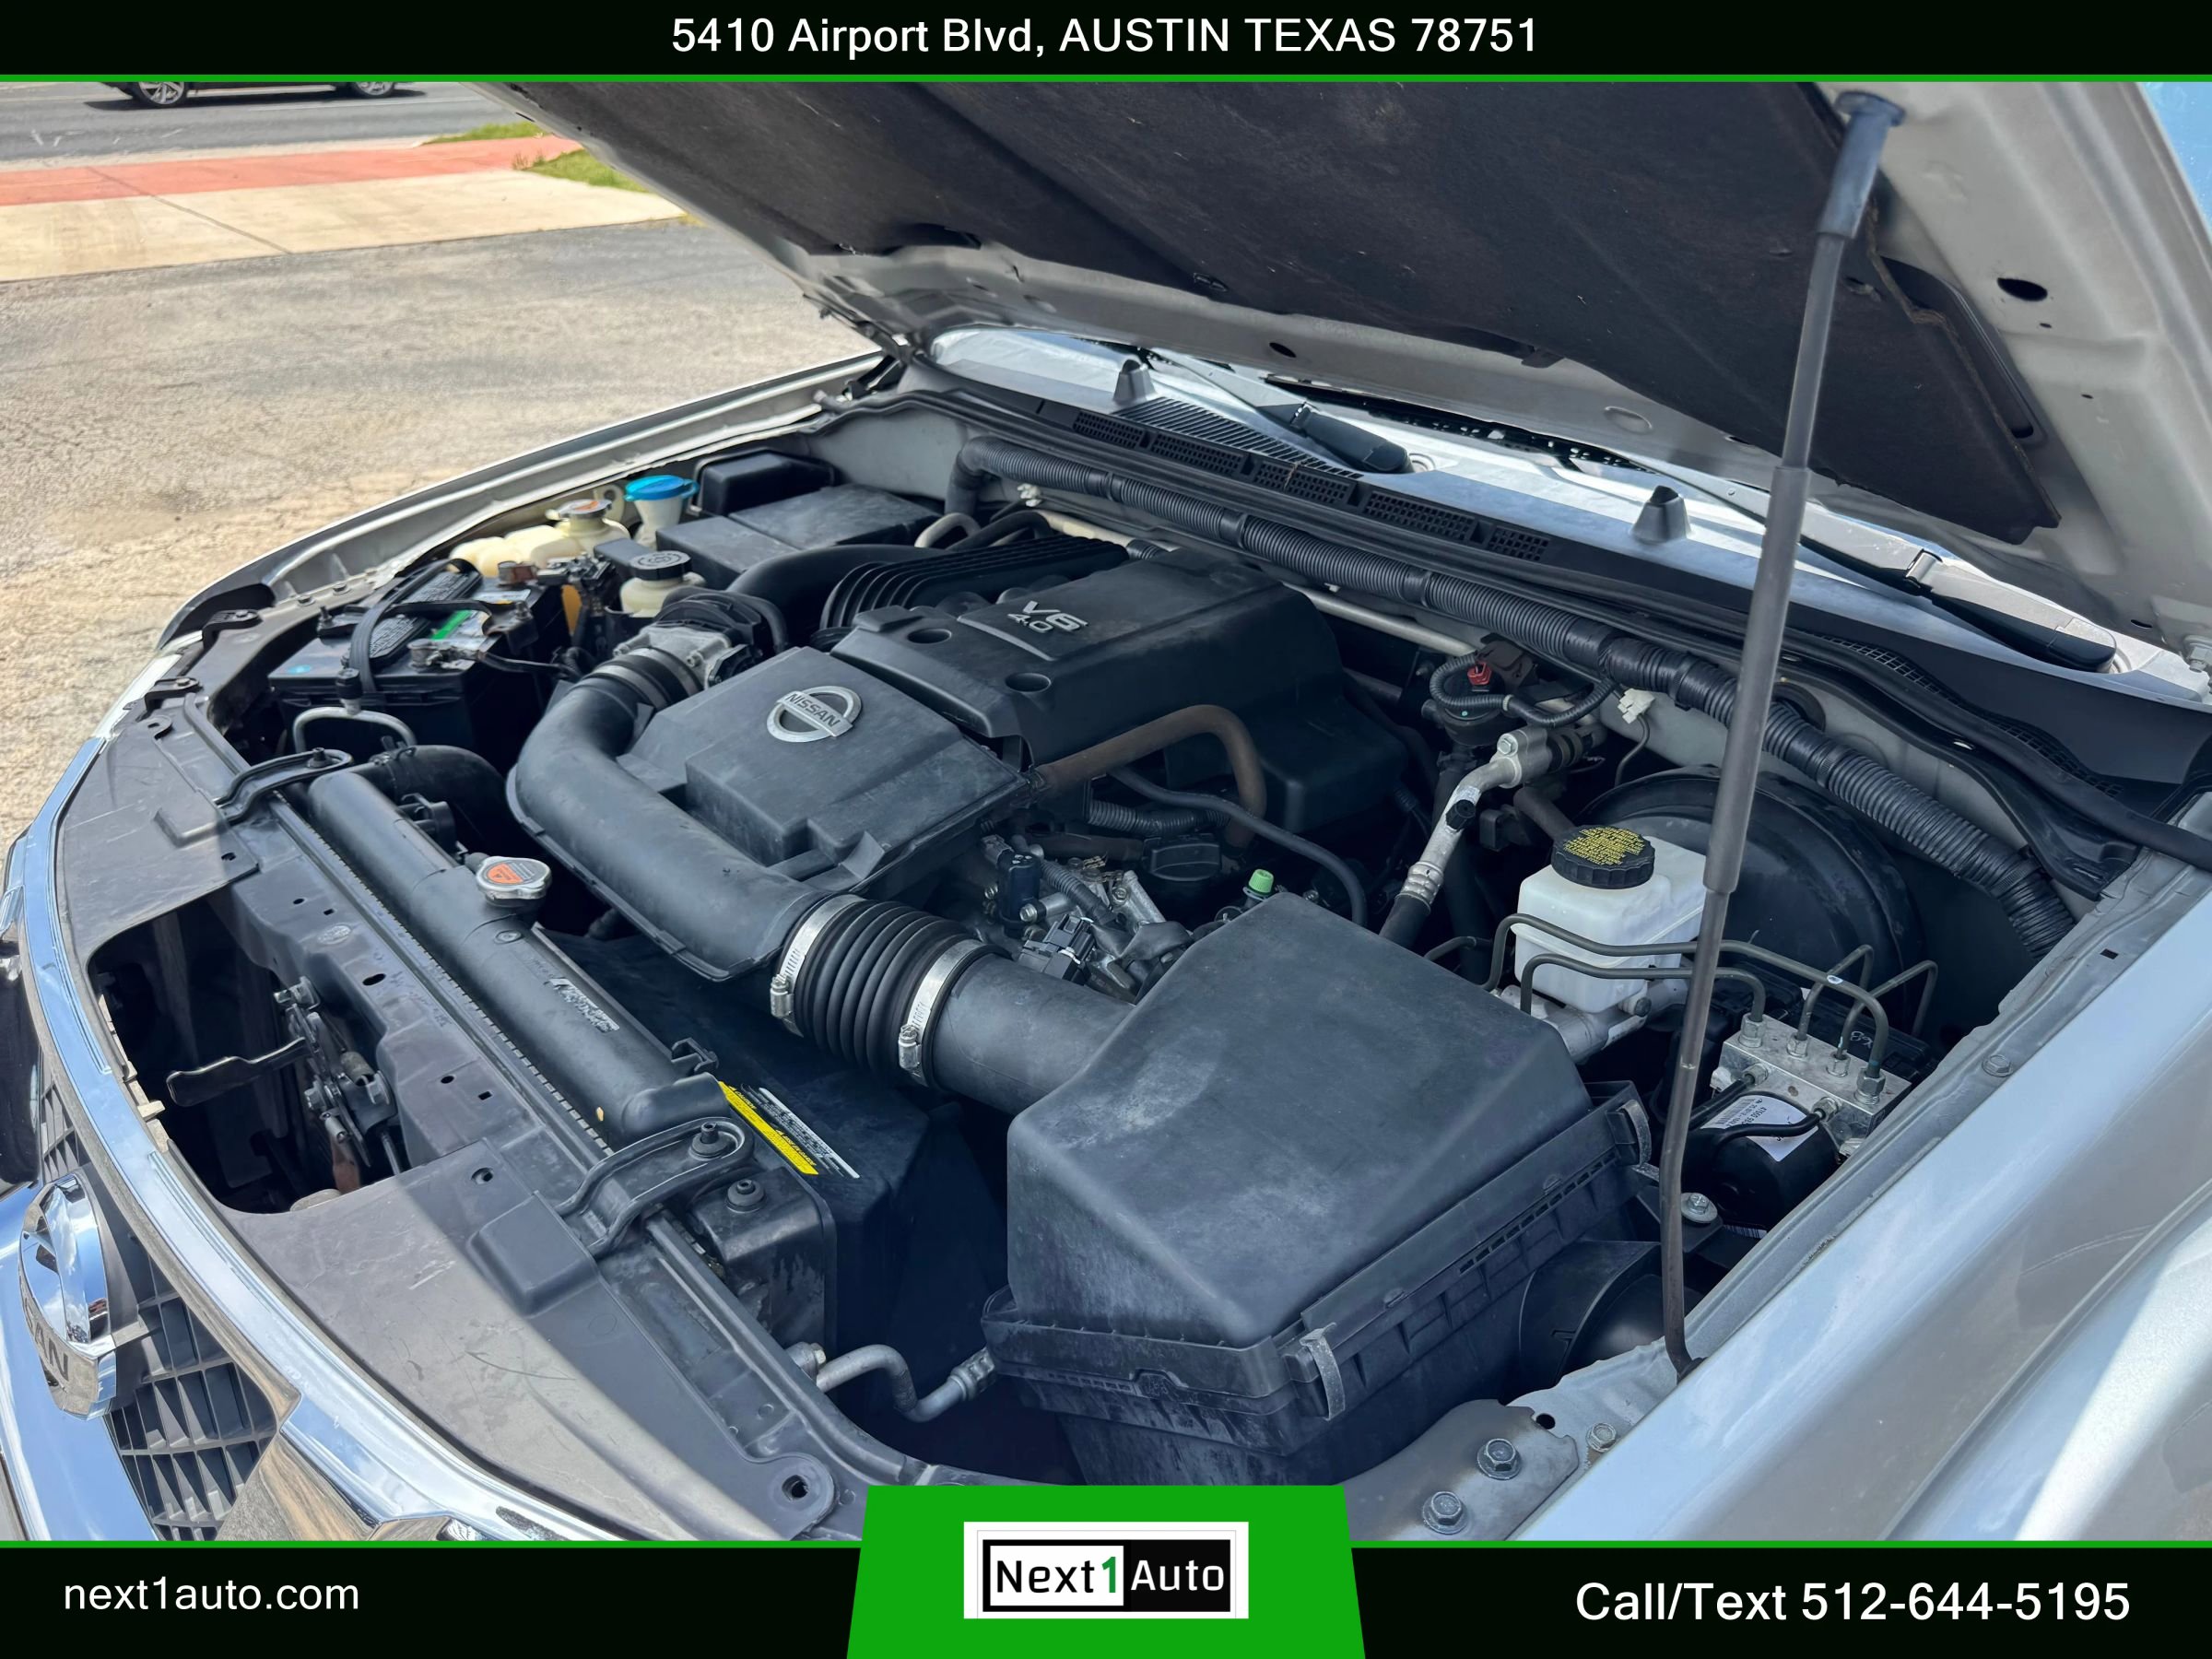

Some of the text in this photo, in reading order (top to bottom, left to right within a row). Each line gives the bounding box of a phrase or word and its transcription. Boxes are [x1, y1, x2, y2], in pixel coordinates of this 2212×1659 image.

[1006, 612, 1054, 633] 4.0
[1022, 600, 1088, 631] V6
[784, 693, 841, 727] NISSAN
